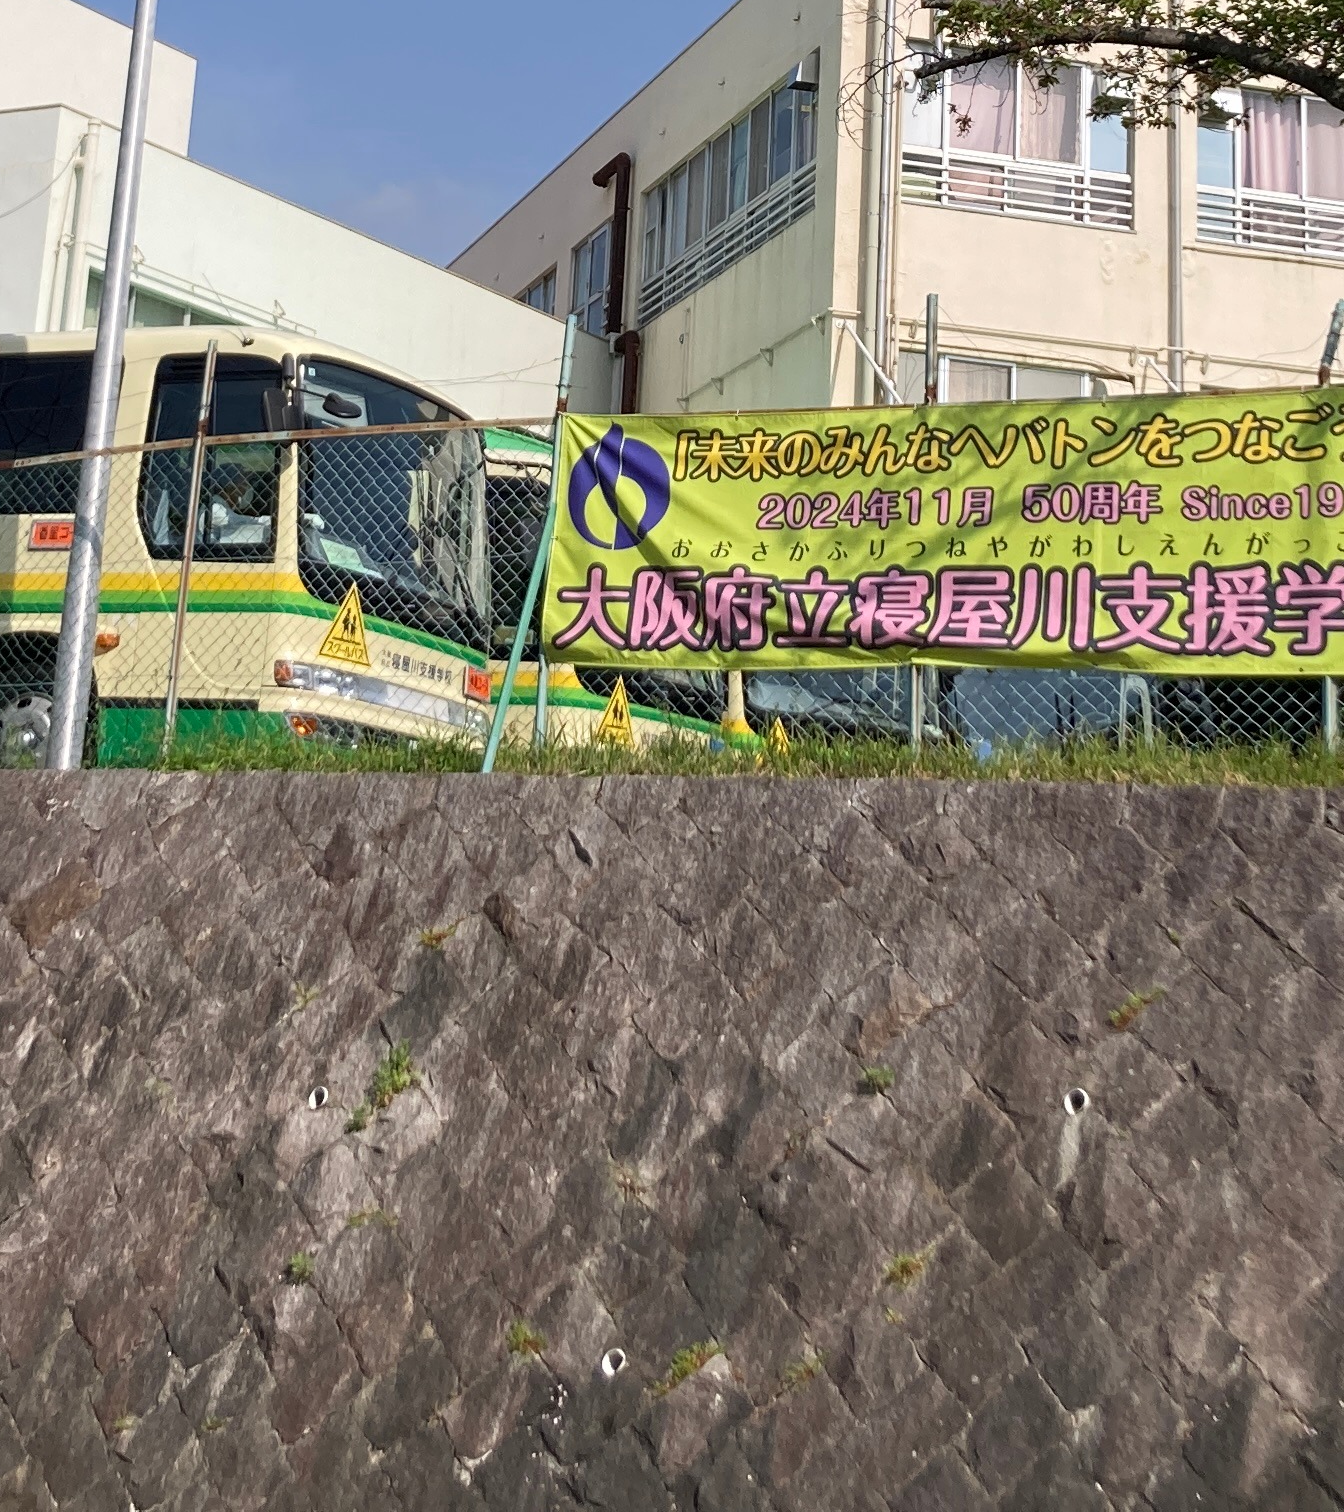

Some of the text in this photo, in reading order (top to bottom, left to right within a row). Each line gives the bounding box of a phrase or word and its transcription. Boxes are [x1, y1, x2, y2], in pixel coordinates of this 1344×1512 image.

[756, 486, 995, 530] 2024年11月
[1021, 480, 1163, 525] 50周年
[327, 641, 365, 661] スクールバス
